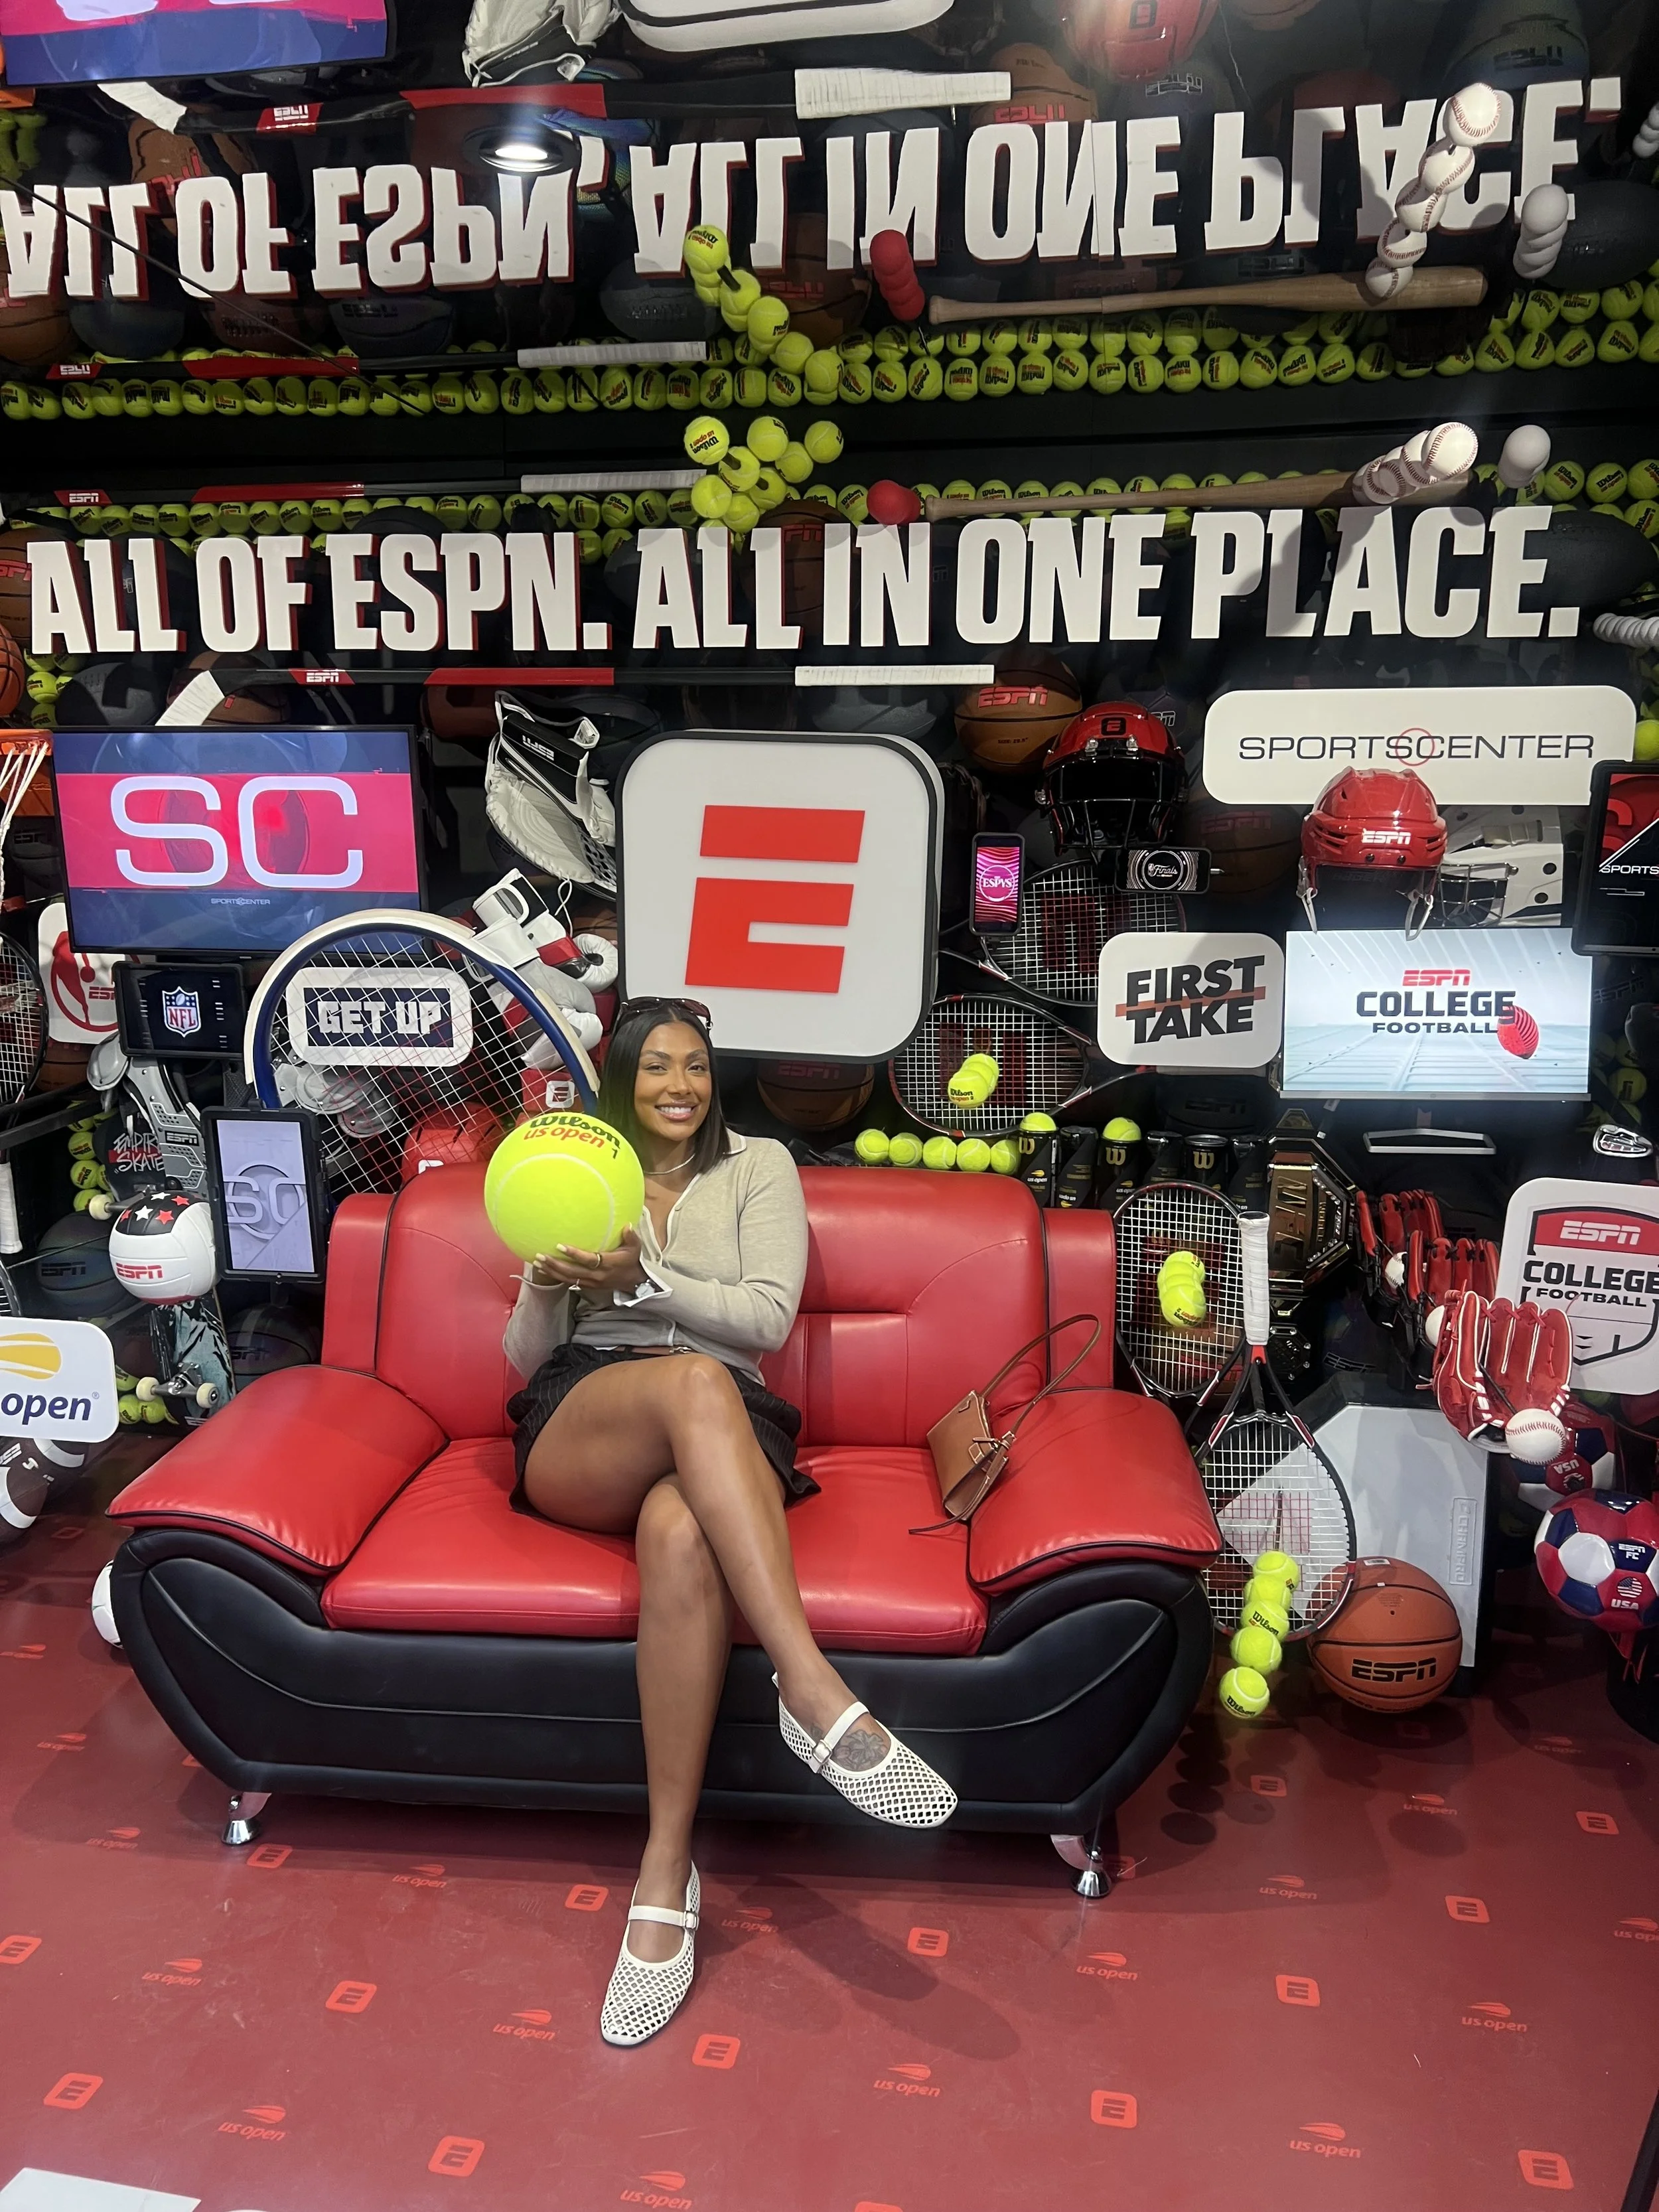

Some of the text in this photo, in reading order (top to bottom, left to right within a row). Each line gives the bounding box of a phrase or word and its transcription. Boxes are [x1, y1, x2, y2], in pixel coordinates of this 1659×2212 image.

[69, 493, 99, 502] ESPN
[27, 506, 1580, 654] ALL OF ESPN. ALL IN ONE PLACE.
[306, 671, 340, 683] ESPN
[978, 685, 1048, 708] ESPN
[1239, 735, 1594, 760] SPORTSCENTER
[111, 775, 364, 889] SC
[1362, 829, 1411, 846] ESPN
[983, 875, 1013, 889] ESPYS
[1127, 955, 1265, 1007] FIRST
[1402, 969, 1471, 986] ESPN
[1356, 991, 1516, 1018] COLLEGE
[168, 1007, 197, 1029] NFL
[317, 1001, 442, 1035] GET UP
[1127, 999, 1254, 1045] TAKE
[1372, 1022, 1499, 1034] FOOTBALL
[167, 1132, 198, 1144] ESPN
[530, 1116, 620, 1149] Wilson
[113, 1132, 161, 1154] EMPIR
[524, 1127, 618, 1159] us open 1
[1560, 1220, 1641, 1245] ESPN
[115, 1262, 164, 1280] ESPN
[1523, 1260, 1659, 1295] COLLEGE
[1536, 1288, 1647, 1307] FOOTBALL
[1553, 1459, 1580, 1475] USA
[1619, 1543, 1646, 1553] ESPN
[1626, 1552, 1639, 1560] FC
[1611, 1599, 1639, 1610] USA
[1253, 1611, 1279, 1637] Wilson
[1352, 1657, 1437, 1683] ESPN
[1227, 1695, 1256, 1716] Wilson
[1278, 1887, 1317, 1901] open
[164, 1973, 202, 1987] open
[1097, 1966, 1138, 1981] open
[514, 2024, 556, 2042] open
[1484, 2018, 1528, 2033] open
[895, 2080, 941, 2099] open
[242, 2124, 286, 2142] open
[1313, 2140, 1361, 2160] open
[643, 2189, 693, 2211] open
